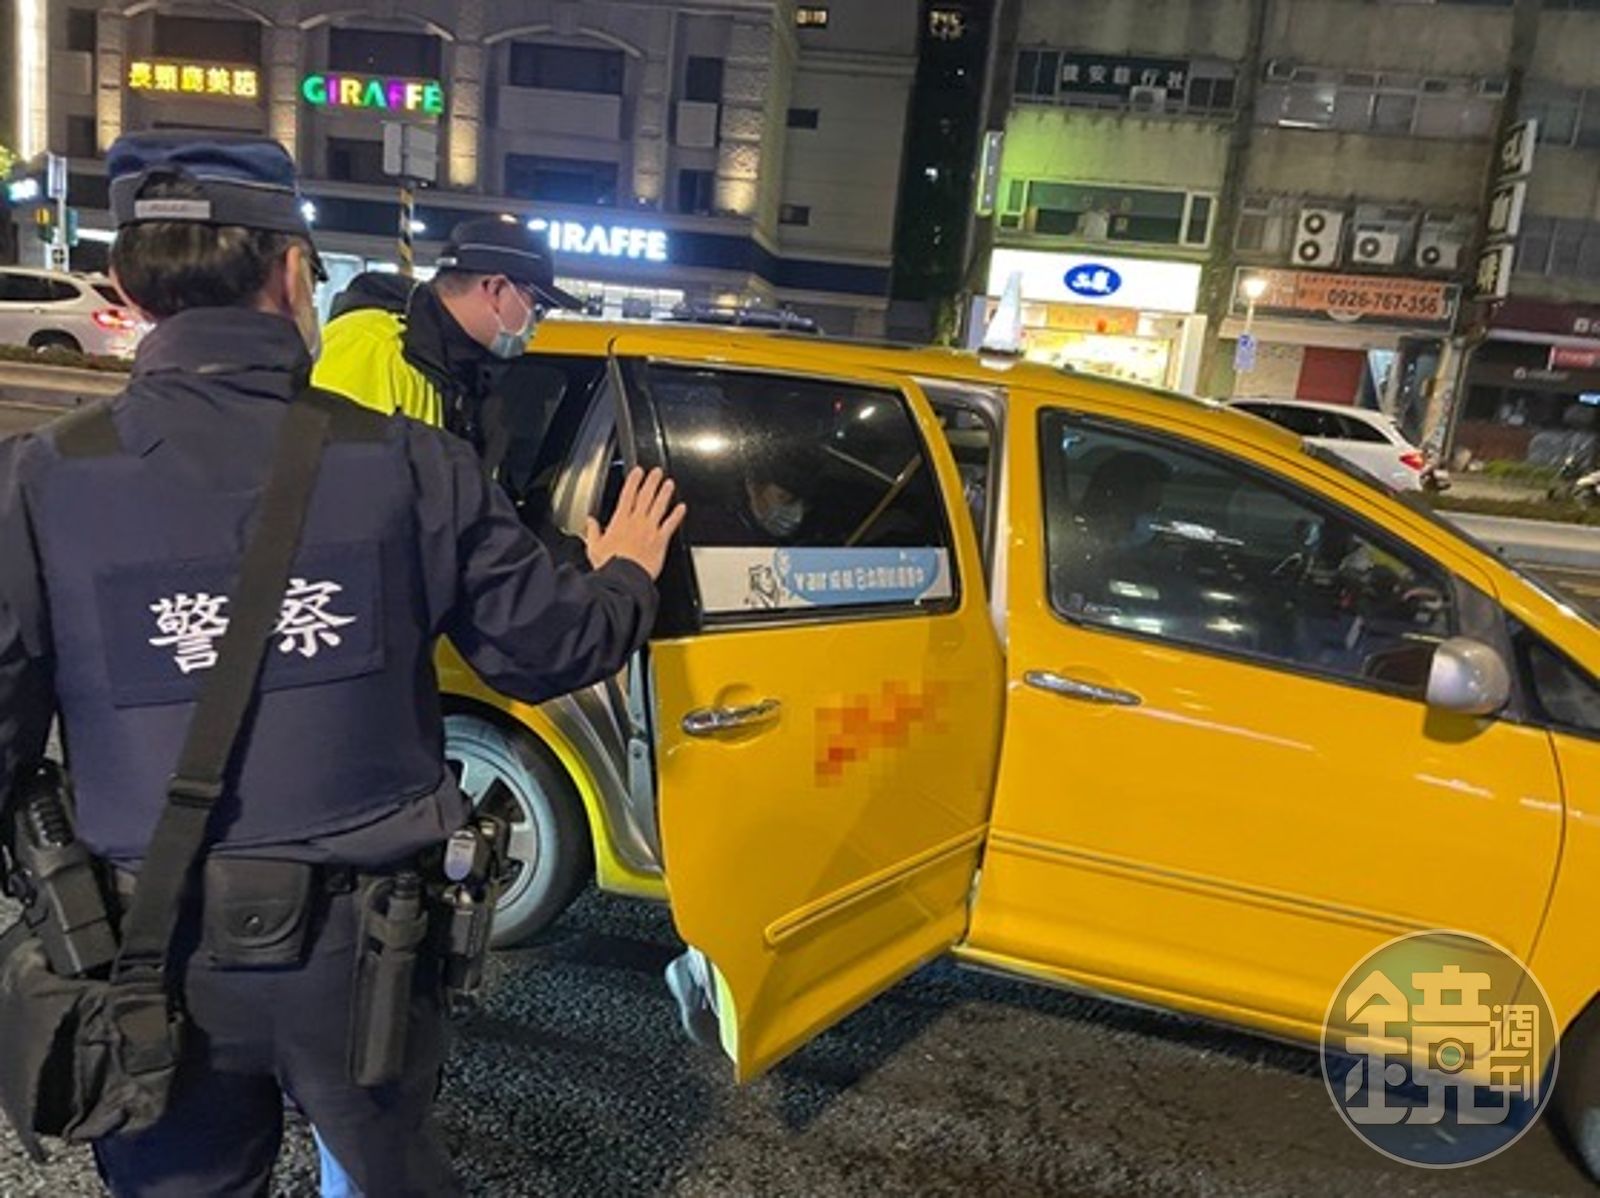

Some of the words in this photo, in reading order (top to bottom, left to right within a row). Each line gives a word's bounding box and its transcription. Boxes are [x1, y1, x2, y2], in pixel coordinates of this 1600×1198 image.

[303, 73, 444, 114] GIRAFFE
[527, 219, 668, 261] IRAFFE
[149, 578, 356, 674] 警察
